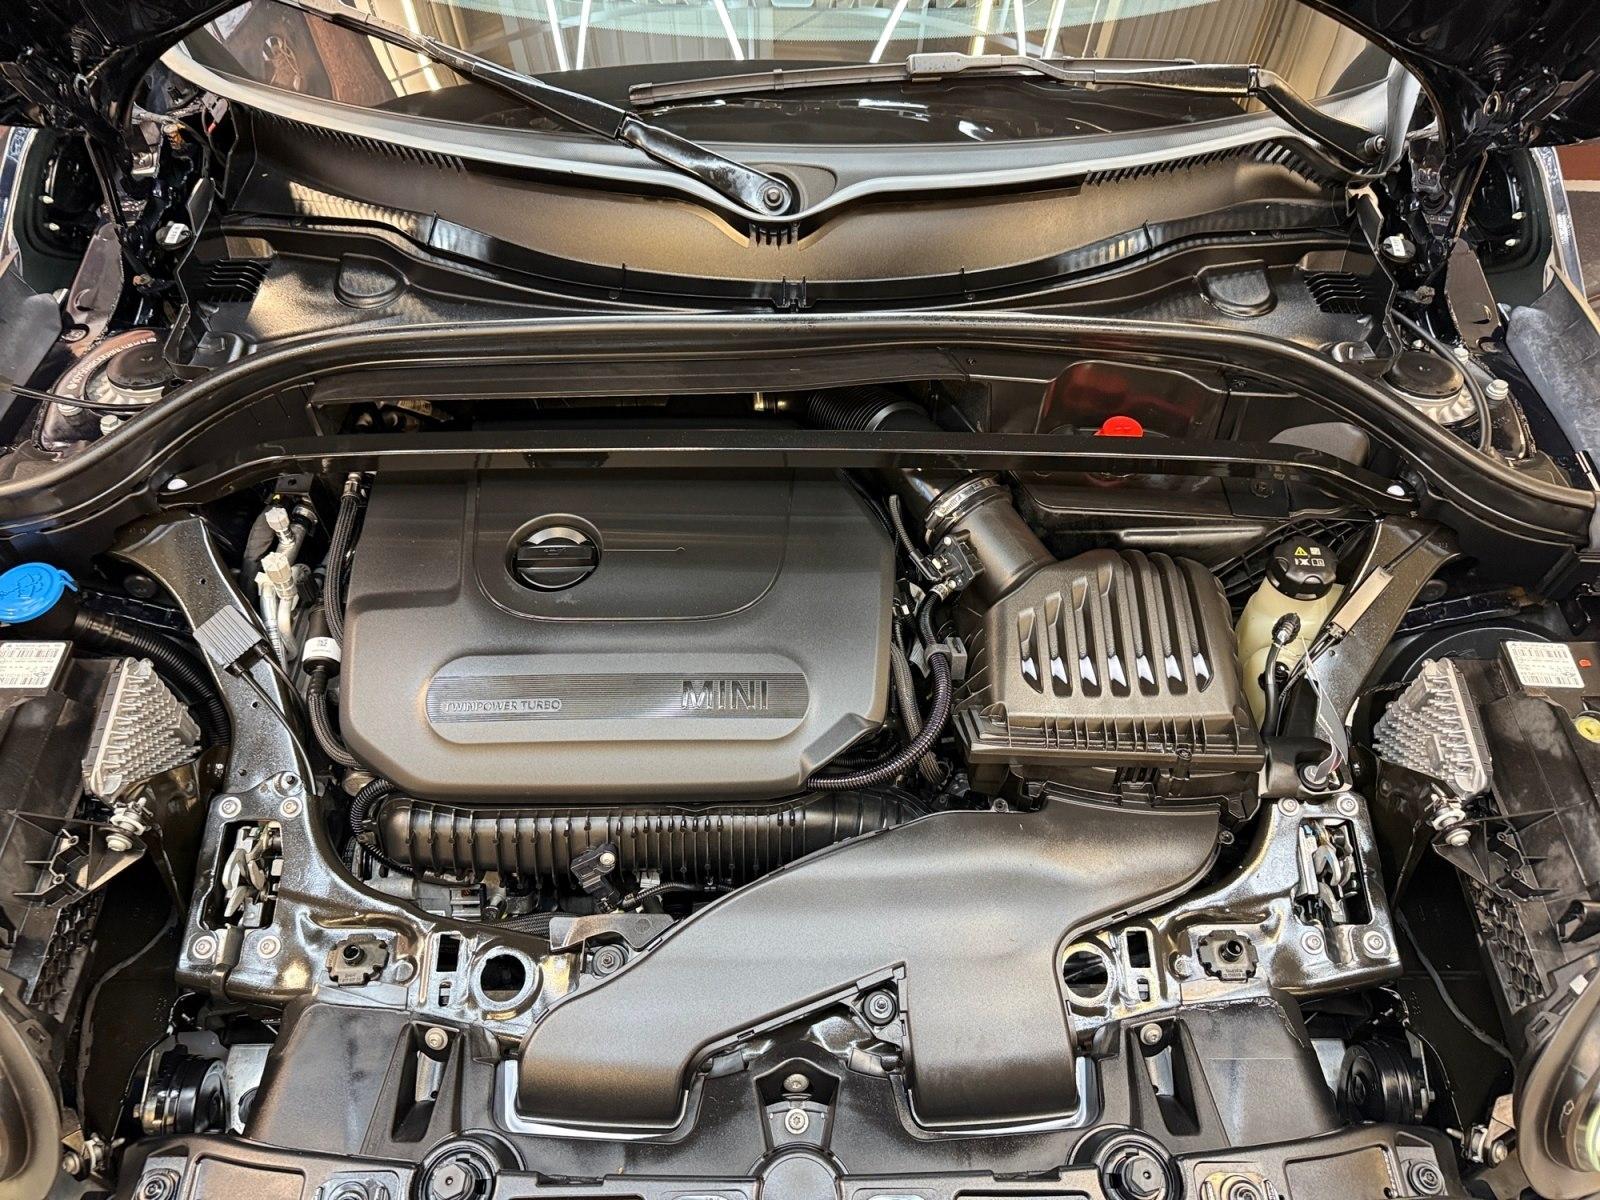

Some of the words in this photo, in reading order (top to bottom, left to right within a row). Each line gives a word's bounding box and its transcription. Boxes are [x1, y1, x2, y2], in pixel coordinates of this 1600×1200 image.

[445, 700, 518, 713] TWINPOWER
[520, 699, 561, 711] TURBO
[681, 680, 768, 710] MINI
